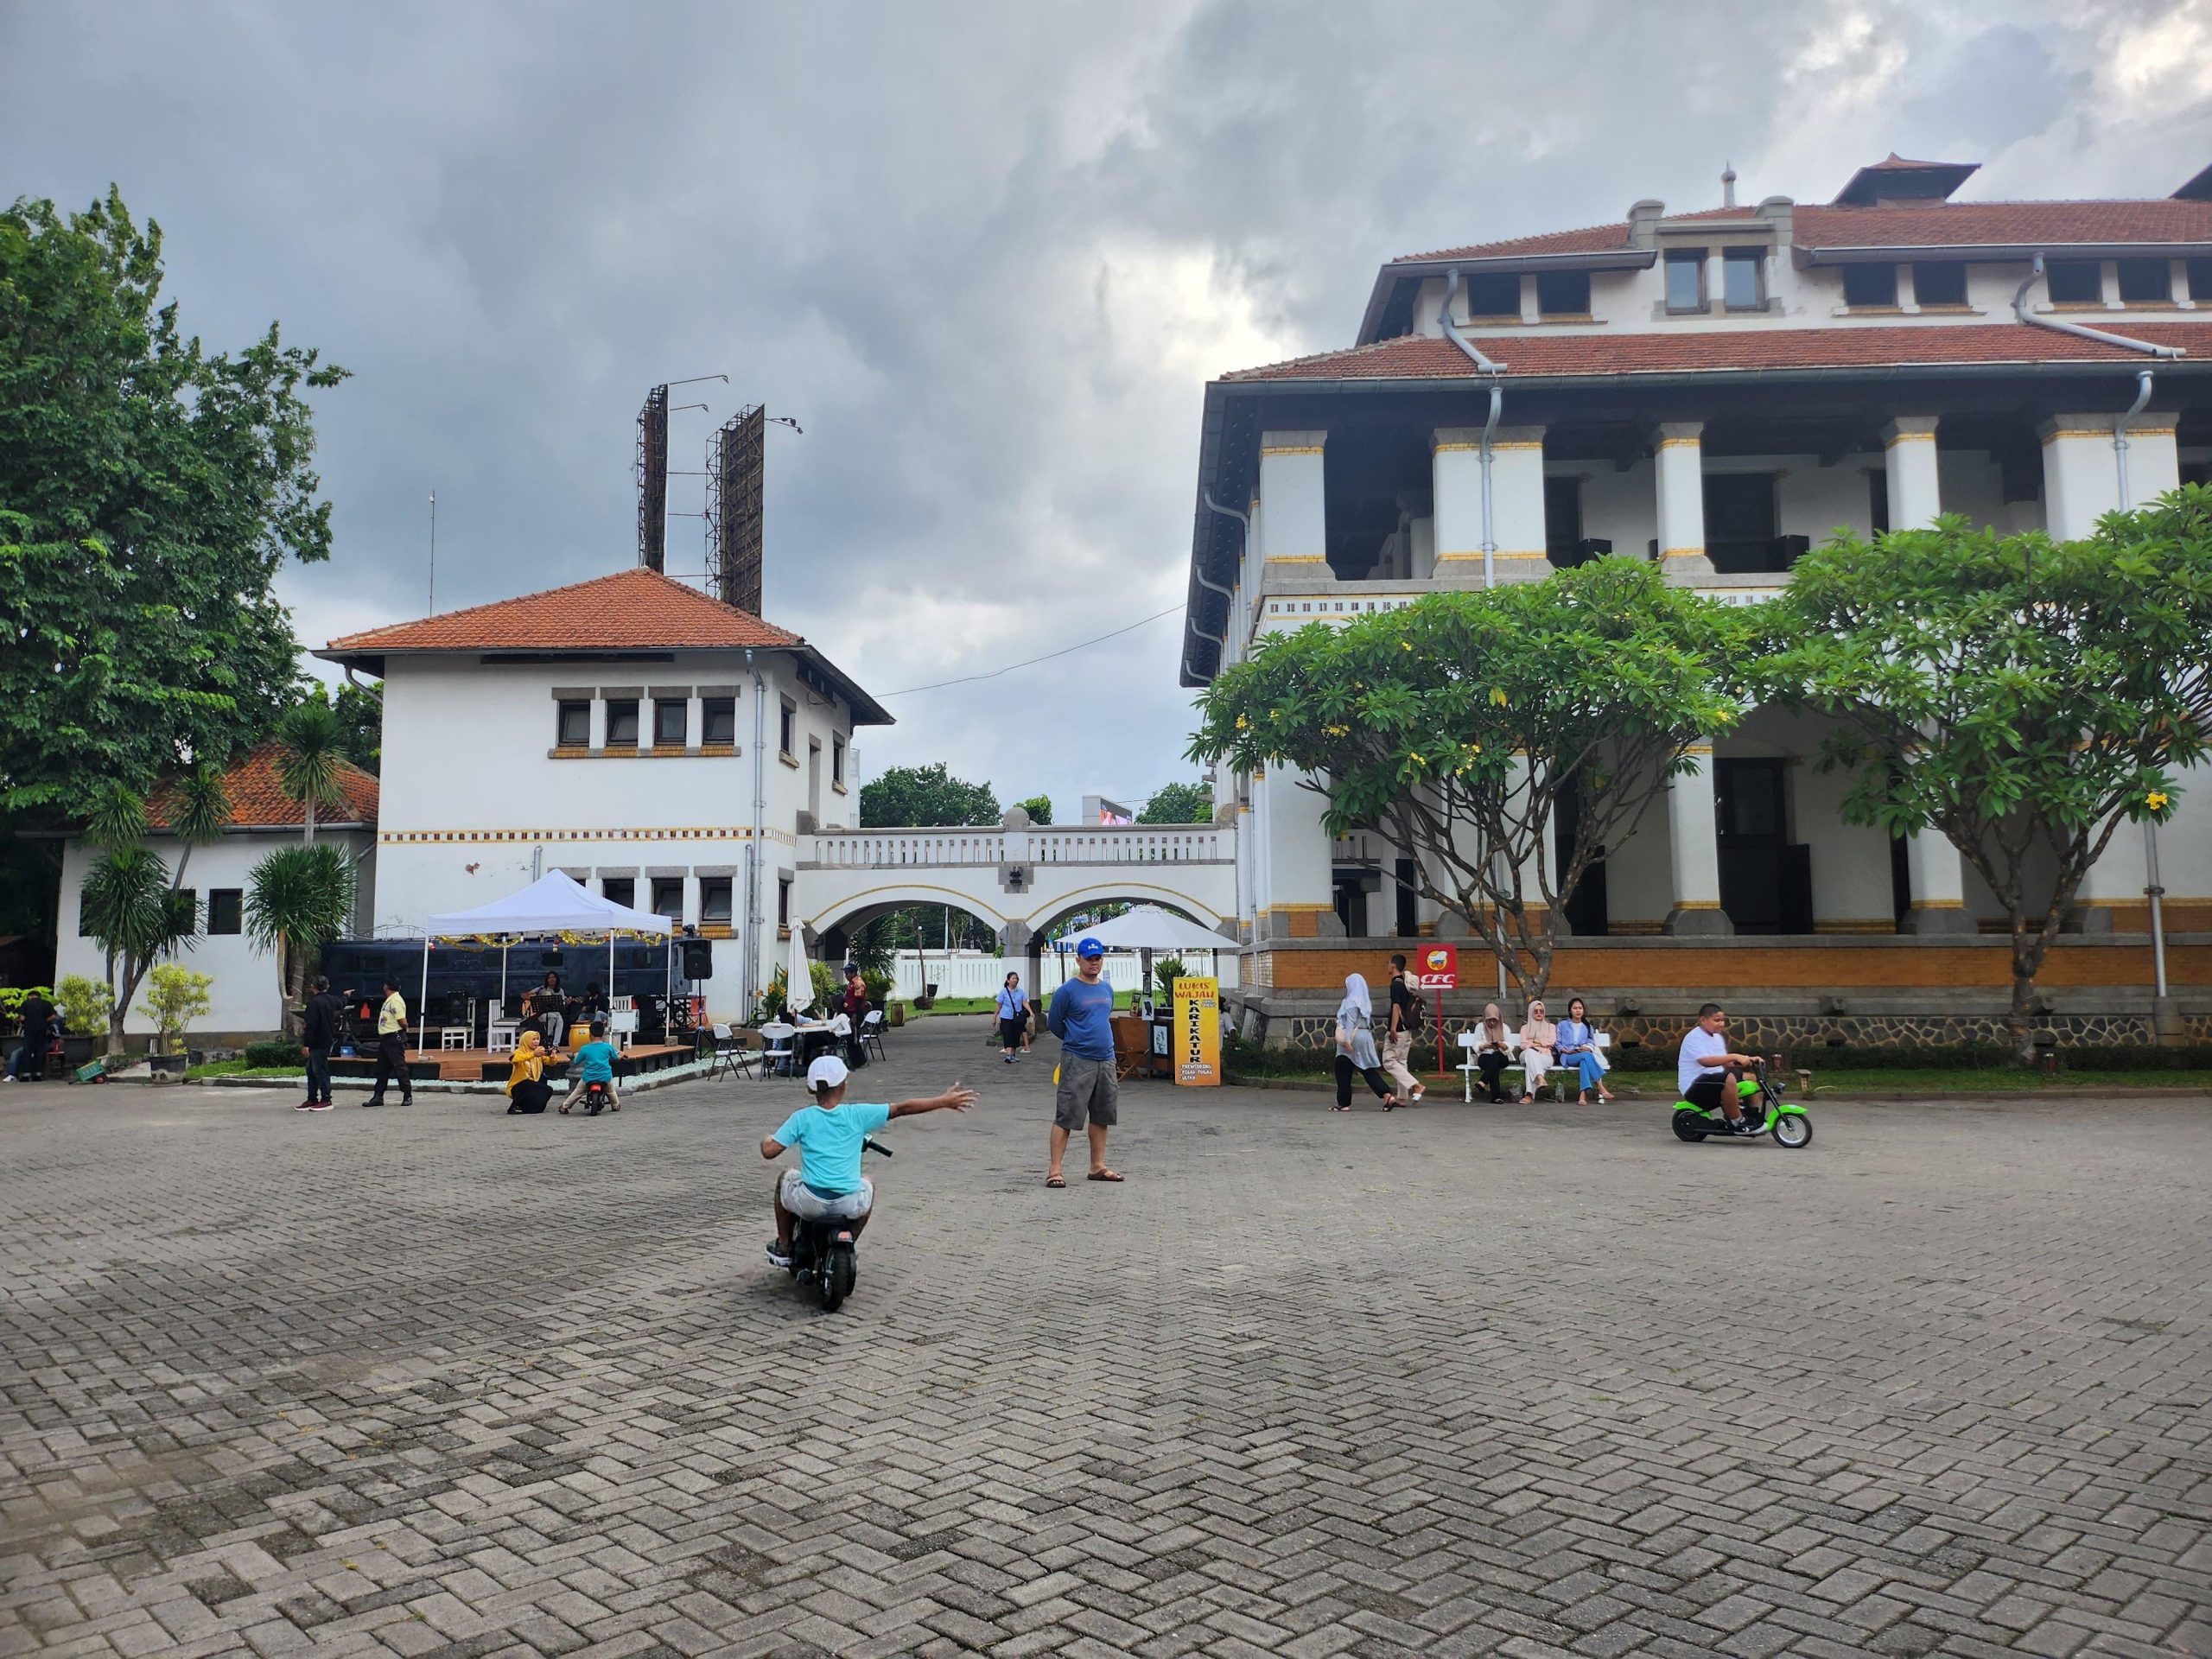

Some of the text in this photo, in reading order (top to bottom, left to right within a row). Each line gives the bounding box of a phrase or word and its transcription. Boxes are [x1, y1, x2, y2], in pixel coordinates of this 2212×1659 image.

[1421, 974, 1455, 983] CFC
[1179, 982, 1211, 990] LUKIS
[1175, 990, 1214, 999] WAJAH
[1188, 999, 1201, 1063] KARIKATUR
